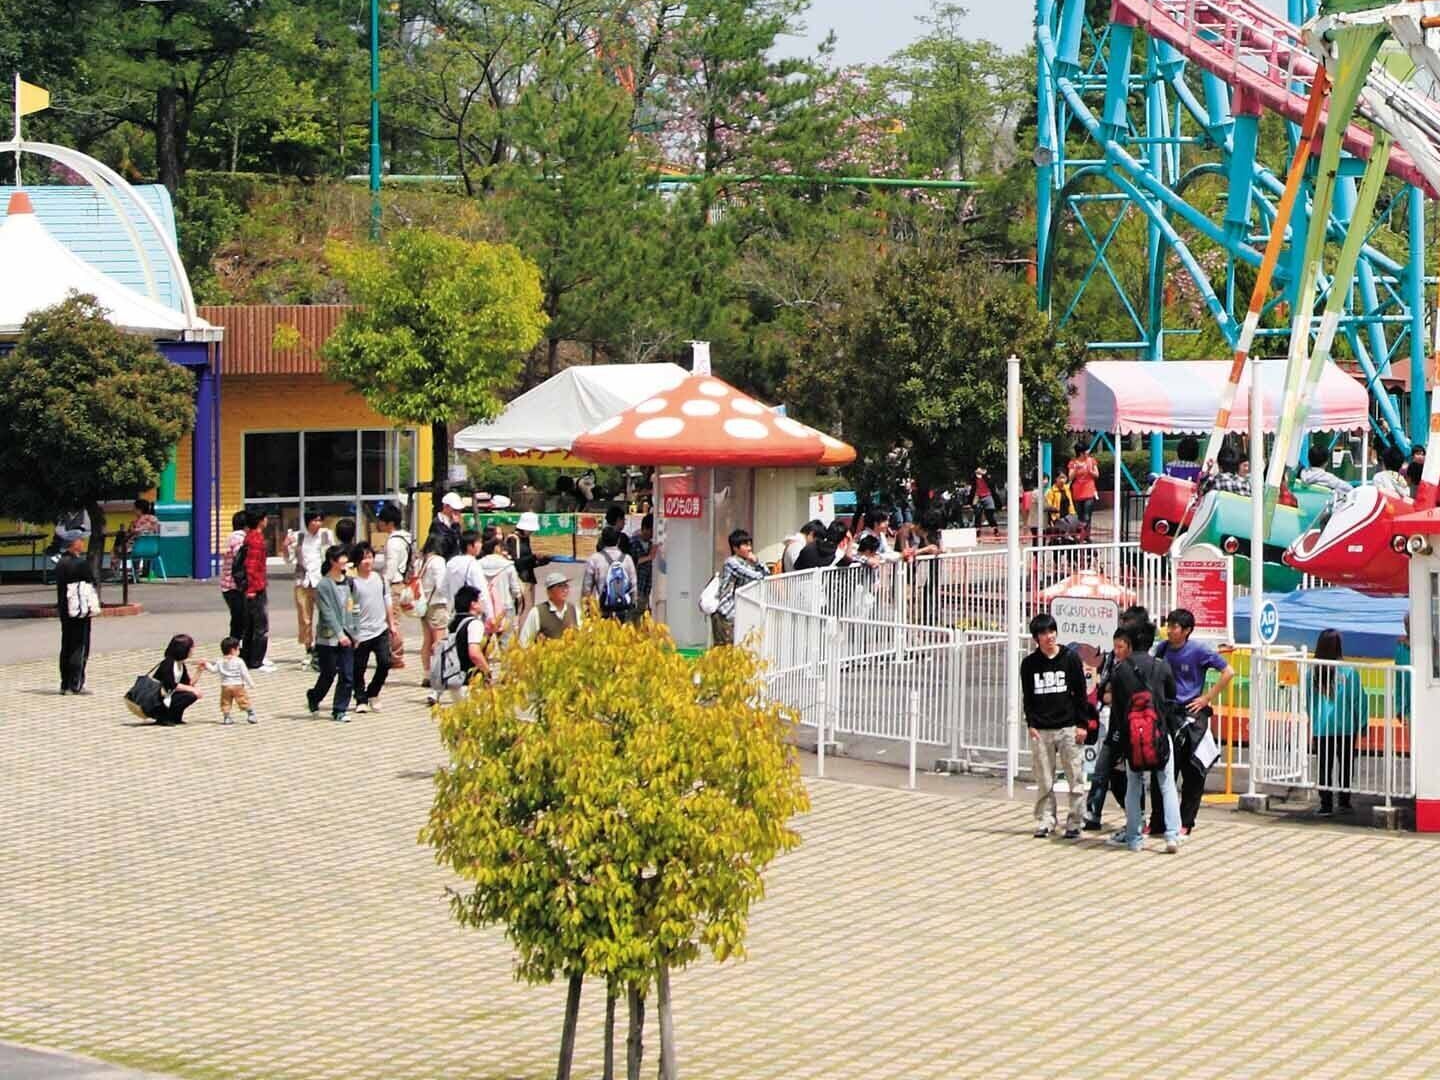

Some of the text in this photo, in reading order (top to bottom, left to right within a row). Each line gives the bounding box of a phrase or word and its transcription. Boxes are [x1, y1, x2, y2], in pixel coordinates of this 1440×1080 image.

[665, 496, 700, 516] のりもの券
[1261, 610, 1275, 626] 入口
